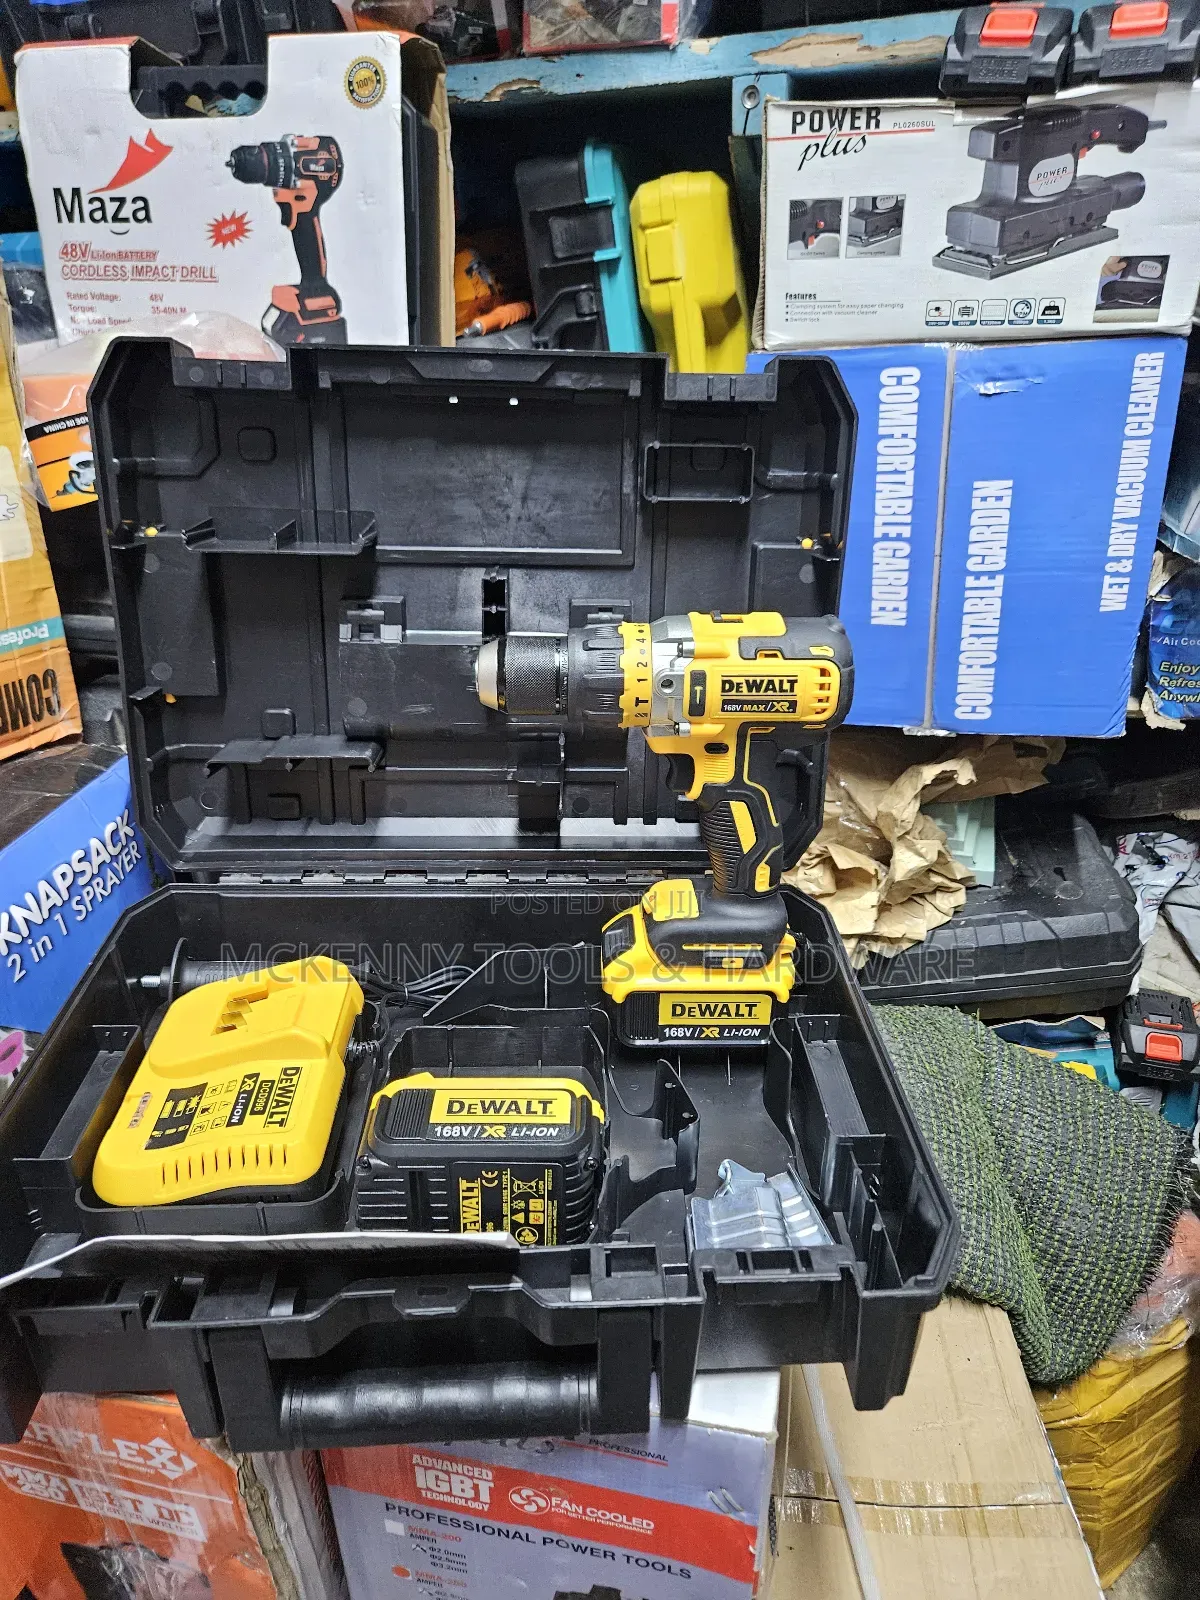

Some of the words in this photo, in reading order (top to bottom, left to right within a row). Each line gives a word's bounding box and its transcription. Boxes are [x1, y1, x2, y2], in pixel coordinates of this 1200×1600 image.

[356, 76, 375, 89] 100%
[791, 107, 882, 135] POWER
[798, 127, 868, 171] plus
[1037, 166, 1068, 181] POWER
[53, 187, 152, 224] Maza
[60, 242, 91, 262] 48V
[62, 264, 128, 279] CORDLESS
[131, 265, 177, 279] IMPACT
[180, 266, 218, 280] DRILL
[67, 291, 87, 300] Rated
[1128, 351, 1165, 438] CLEANER
[43, 422, 67, 434] CHINA
[66, 419, 75, 427] IN
[75, 416, 89, 426] ADE
[873, 366, 921, 540] COMFORTABLE
[1112, 438, 1152, 525] VACUUM
[966, 479, 1014, 573] GARDEN
[1107, 524, 1139, 556] DRY
[1104, 555, 1133, 574] &
[870, 541, 912, 627] GARDEN
[1099, 575, 1130, 613] WET
[954, 574, 1005, 721] COMFORTABLE
[721, 678, 798, 693] DEWALT
[723, 704, 742, 712] 168V
[0, 809, 136, 957] KNAPSACK
[8, 952, 27, 984] 2
[28, 935, 53, 963] in
[53, 912, 68, 937] 1
[75, 840, 142, 922] SPRAYER
[671, 1003, 758, 1018] DEWALT
[723, 1028, 761, 1037] LI-ION
[229, 1093, 249, 1125] LI-ION
[253, 1081, 274, 1113] DCD996
[266, 1066, 301, 1128] DEWALT
[446, 1099, 553, 1116] DEWALT
[510, 1126, 560, 1137] LI-ION
[589, 1438, 669, 1462] PROFESSIONAL
[1, 1464, 69, 1492] MMA
[412, 1454, 493, 1481] ADVANCED
[18, 1479, 66, 1502] 250
[415, 1466, 494, 1503] IGBT
[421, 1490, 489, 1511] TECHNOLOGY
[551, 1497, 582, 1514] FAN
[586, 1507, 655, 1530] COOLED
[153, 1503, 194, 1528] DC
[551, 1507, 567, 1515] FOR
[568, 1510, 596, 1523] BETTER
[597, 1516, 653, 1535] PERFORMANCE
[385, 1502, 537, 1544] PROFESSIONAL
[542, 1536, 616, 1561] POWER
[622, 1553, 692, 1579] TOOLS
